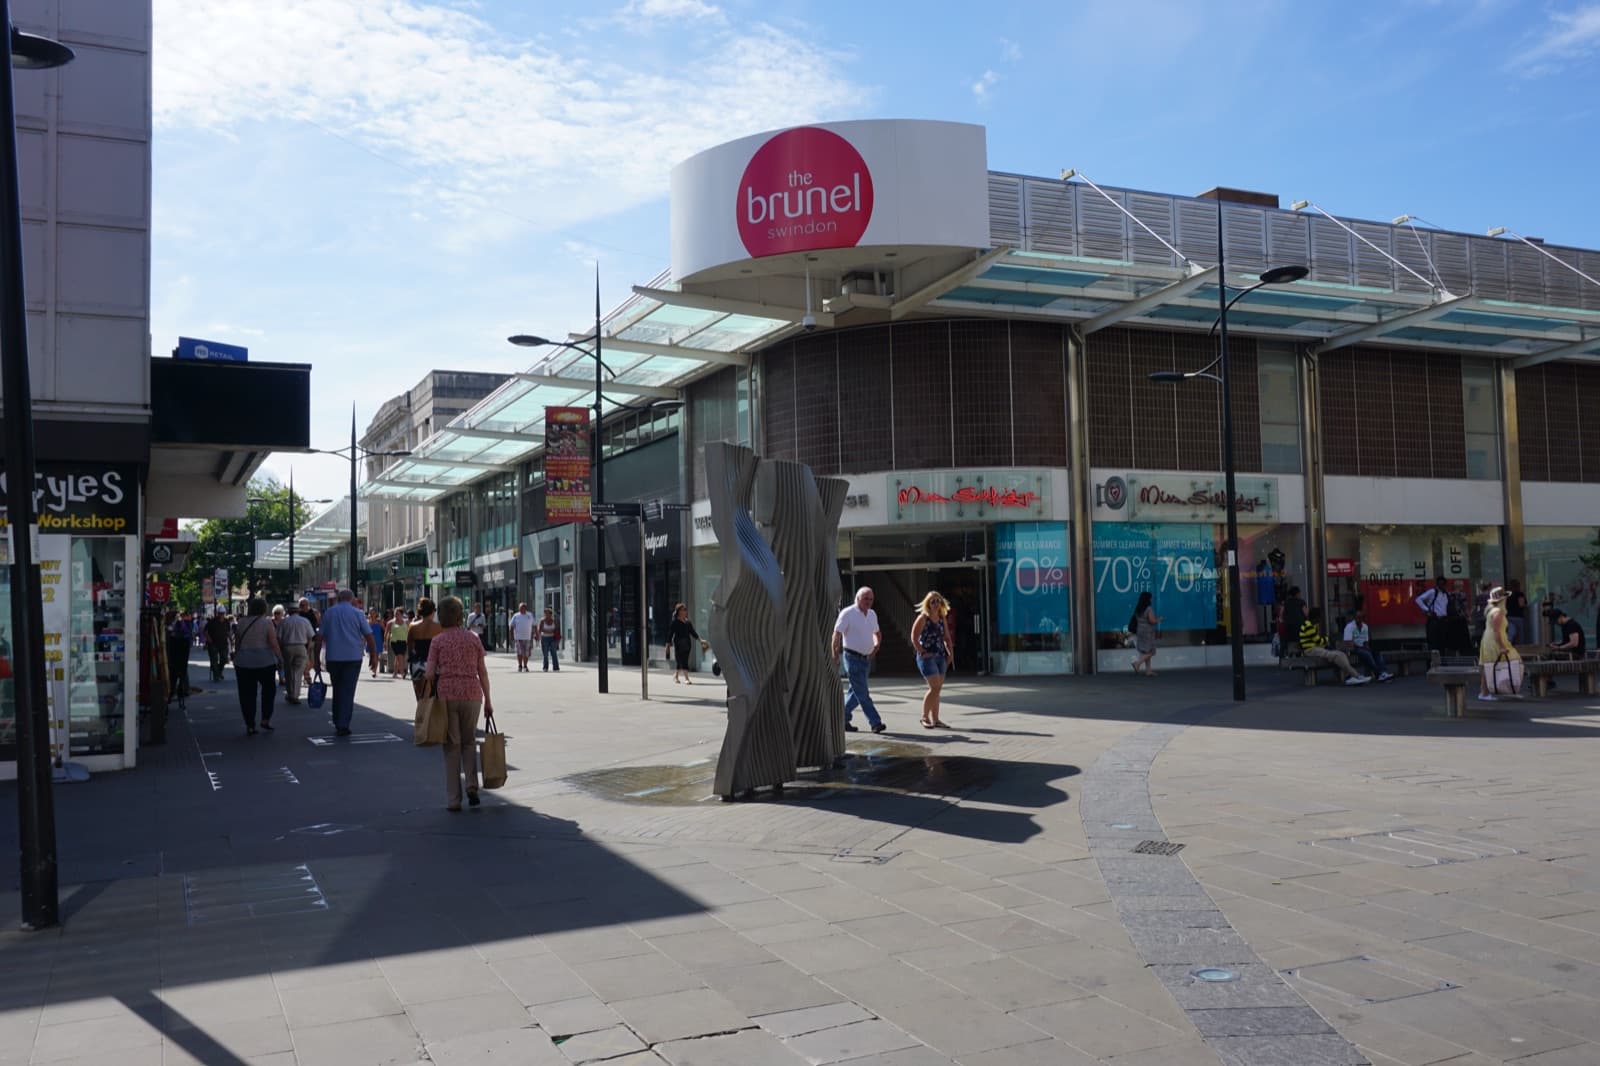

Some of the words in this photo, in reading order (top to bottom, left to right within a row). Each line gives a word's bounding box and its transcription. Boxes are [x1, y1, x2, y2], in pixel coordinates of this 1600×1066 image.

[788, 170, 813, 187] the
[747, 172, 860, 224] brunel
[767, 219, 837, 240] swindon
[1140, 485, 1188, 505] Miss
[37, 513, 126, 533] Workshop
[1450, 547, 1462, 574] OFF
[997, 556, 1063, 595] 70%
[1093, 556, 1151, 592] 70%
[1157, 556, 1210, 592] 70%
[1369, 572, 1404, 587] OUTLET
[1041, 582, 1064, 595] OFF
[1133, 581, 1151, 592] OFF
[1195, 581, 1213, 592] OFF
